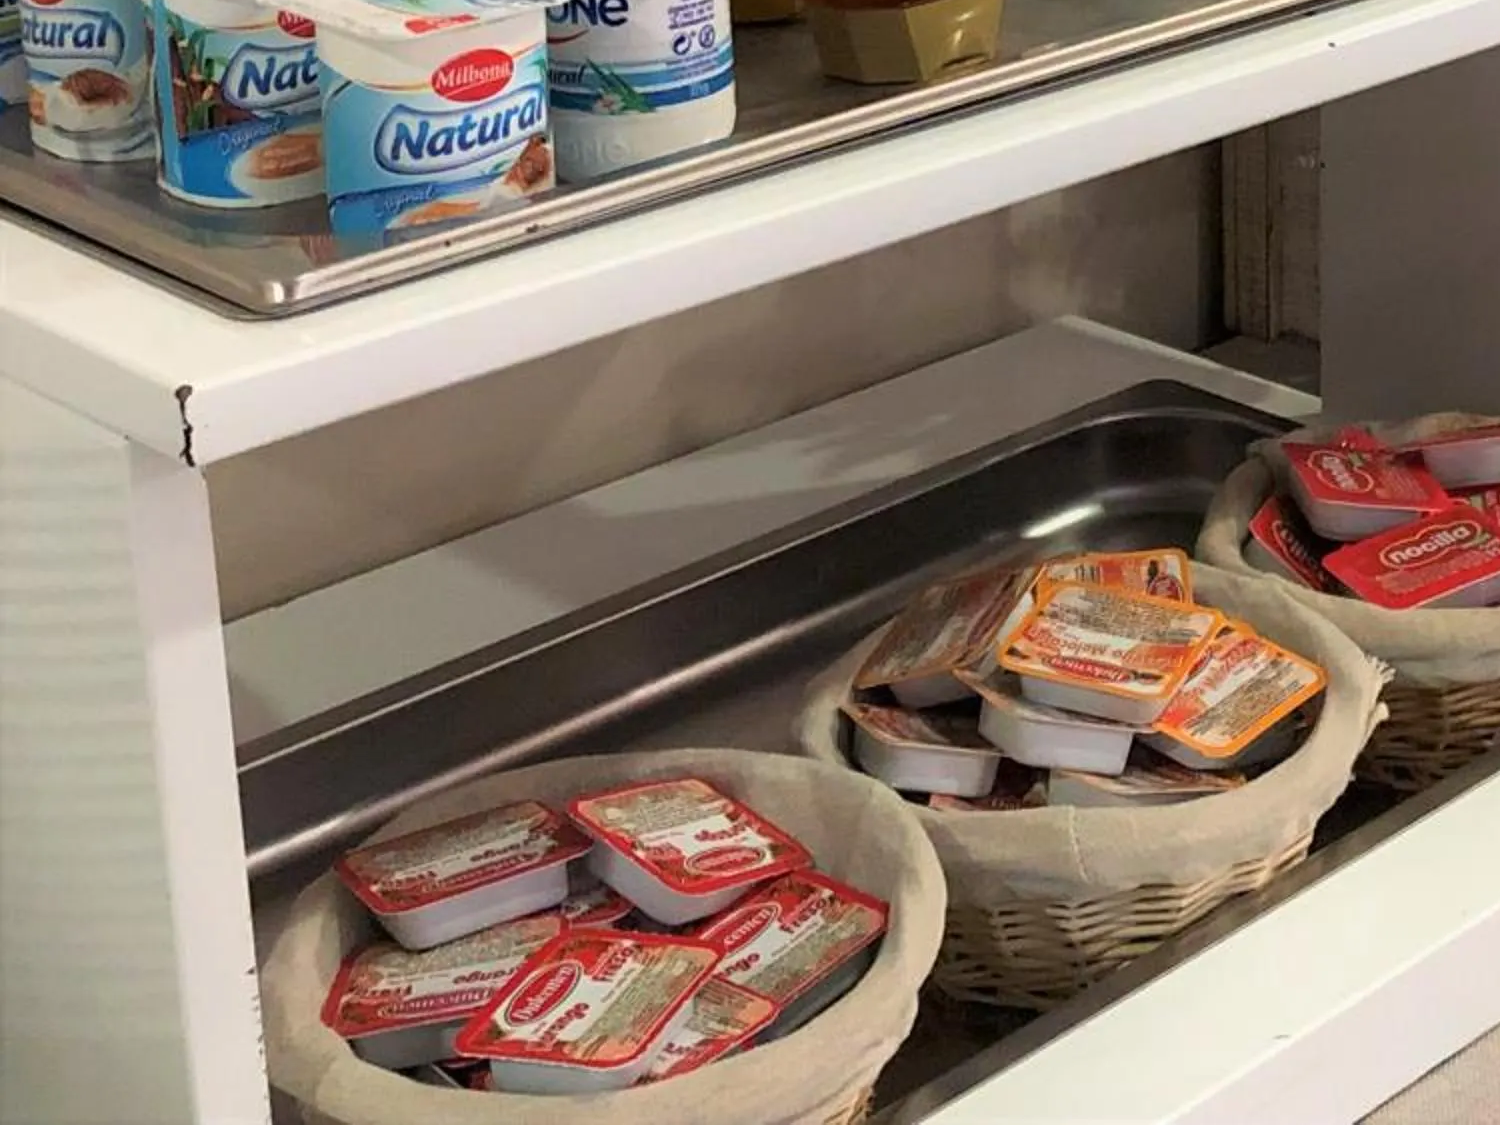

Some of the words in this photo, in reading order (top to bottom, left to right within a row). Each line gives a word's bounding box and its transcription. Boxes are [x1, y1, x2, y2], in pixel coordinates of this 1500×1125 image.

[434, 60, 512, 89] Milbona
[390, 90, 543, 162] Natural
[1387, 525, 1471, 565] nocilla
